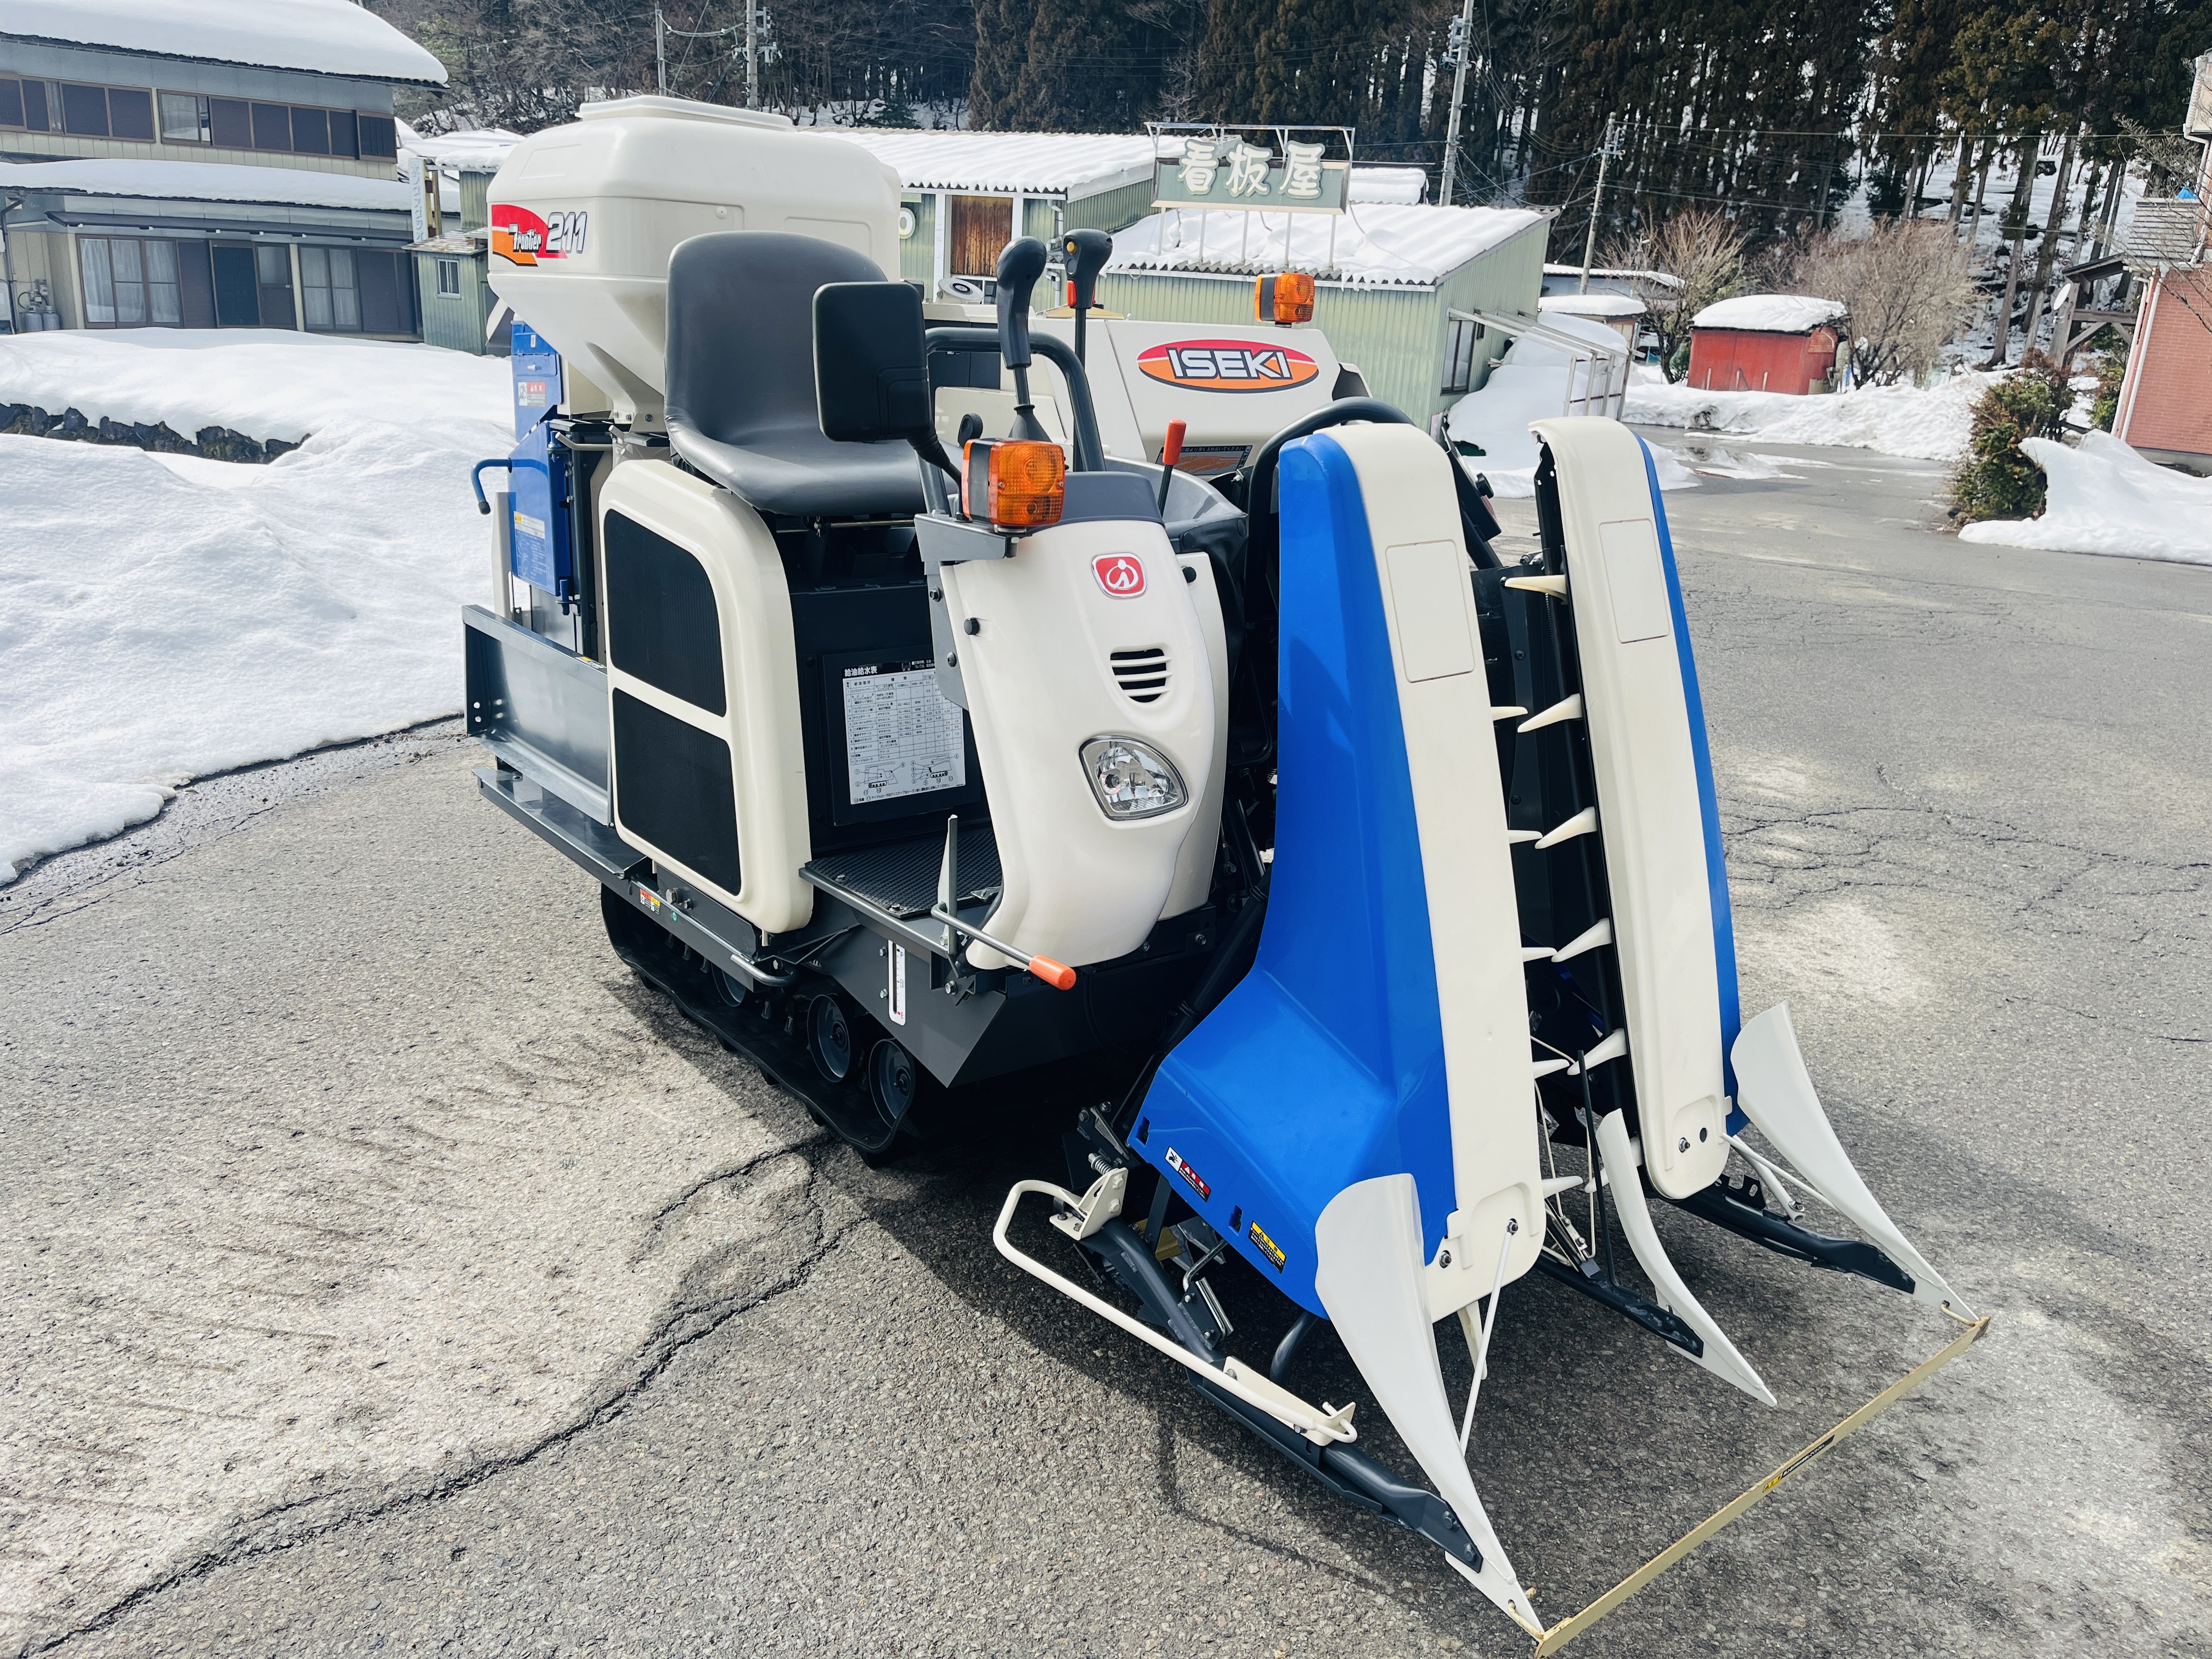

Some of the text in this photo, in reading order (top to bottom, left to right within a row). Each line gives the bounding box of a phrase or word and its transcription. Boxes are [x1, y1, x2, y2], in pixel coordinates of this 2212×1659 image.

[1178, 140, 1324, 196] 看板屋
[509, 212, 588, 254] Frontier 211
[1166, 347, 1293, 380] ISEKI
[845, 666, 877, 676] 給油給水表
